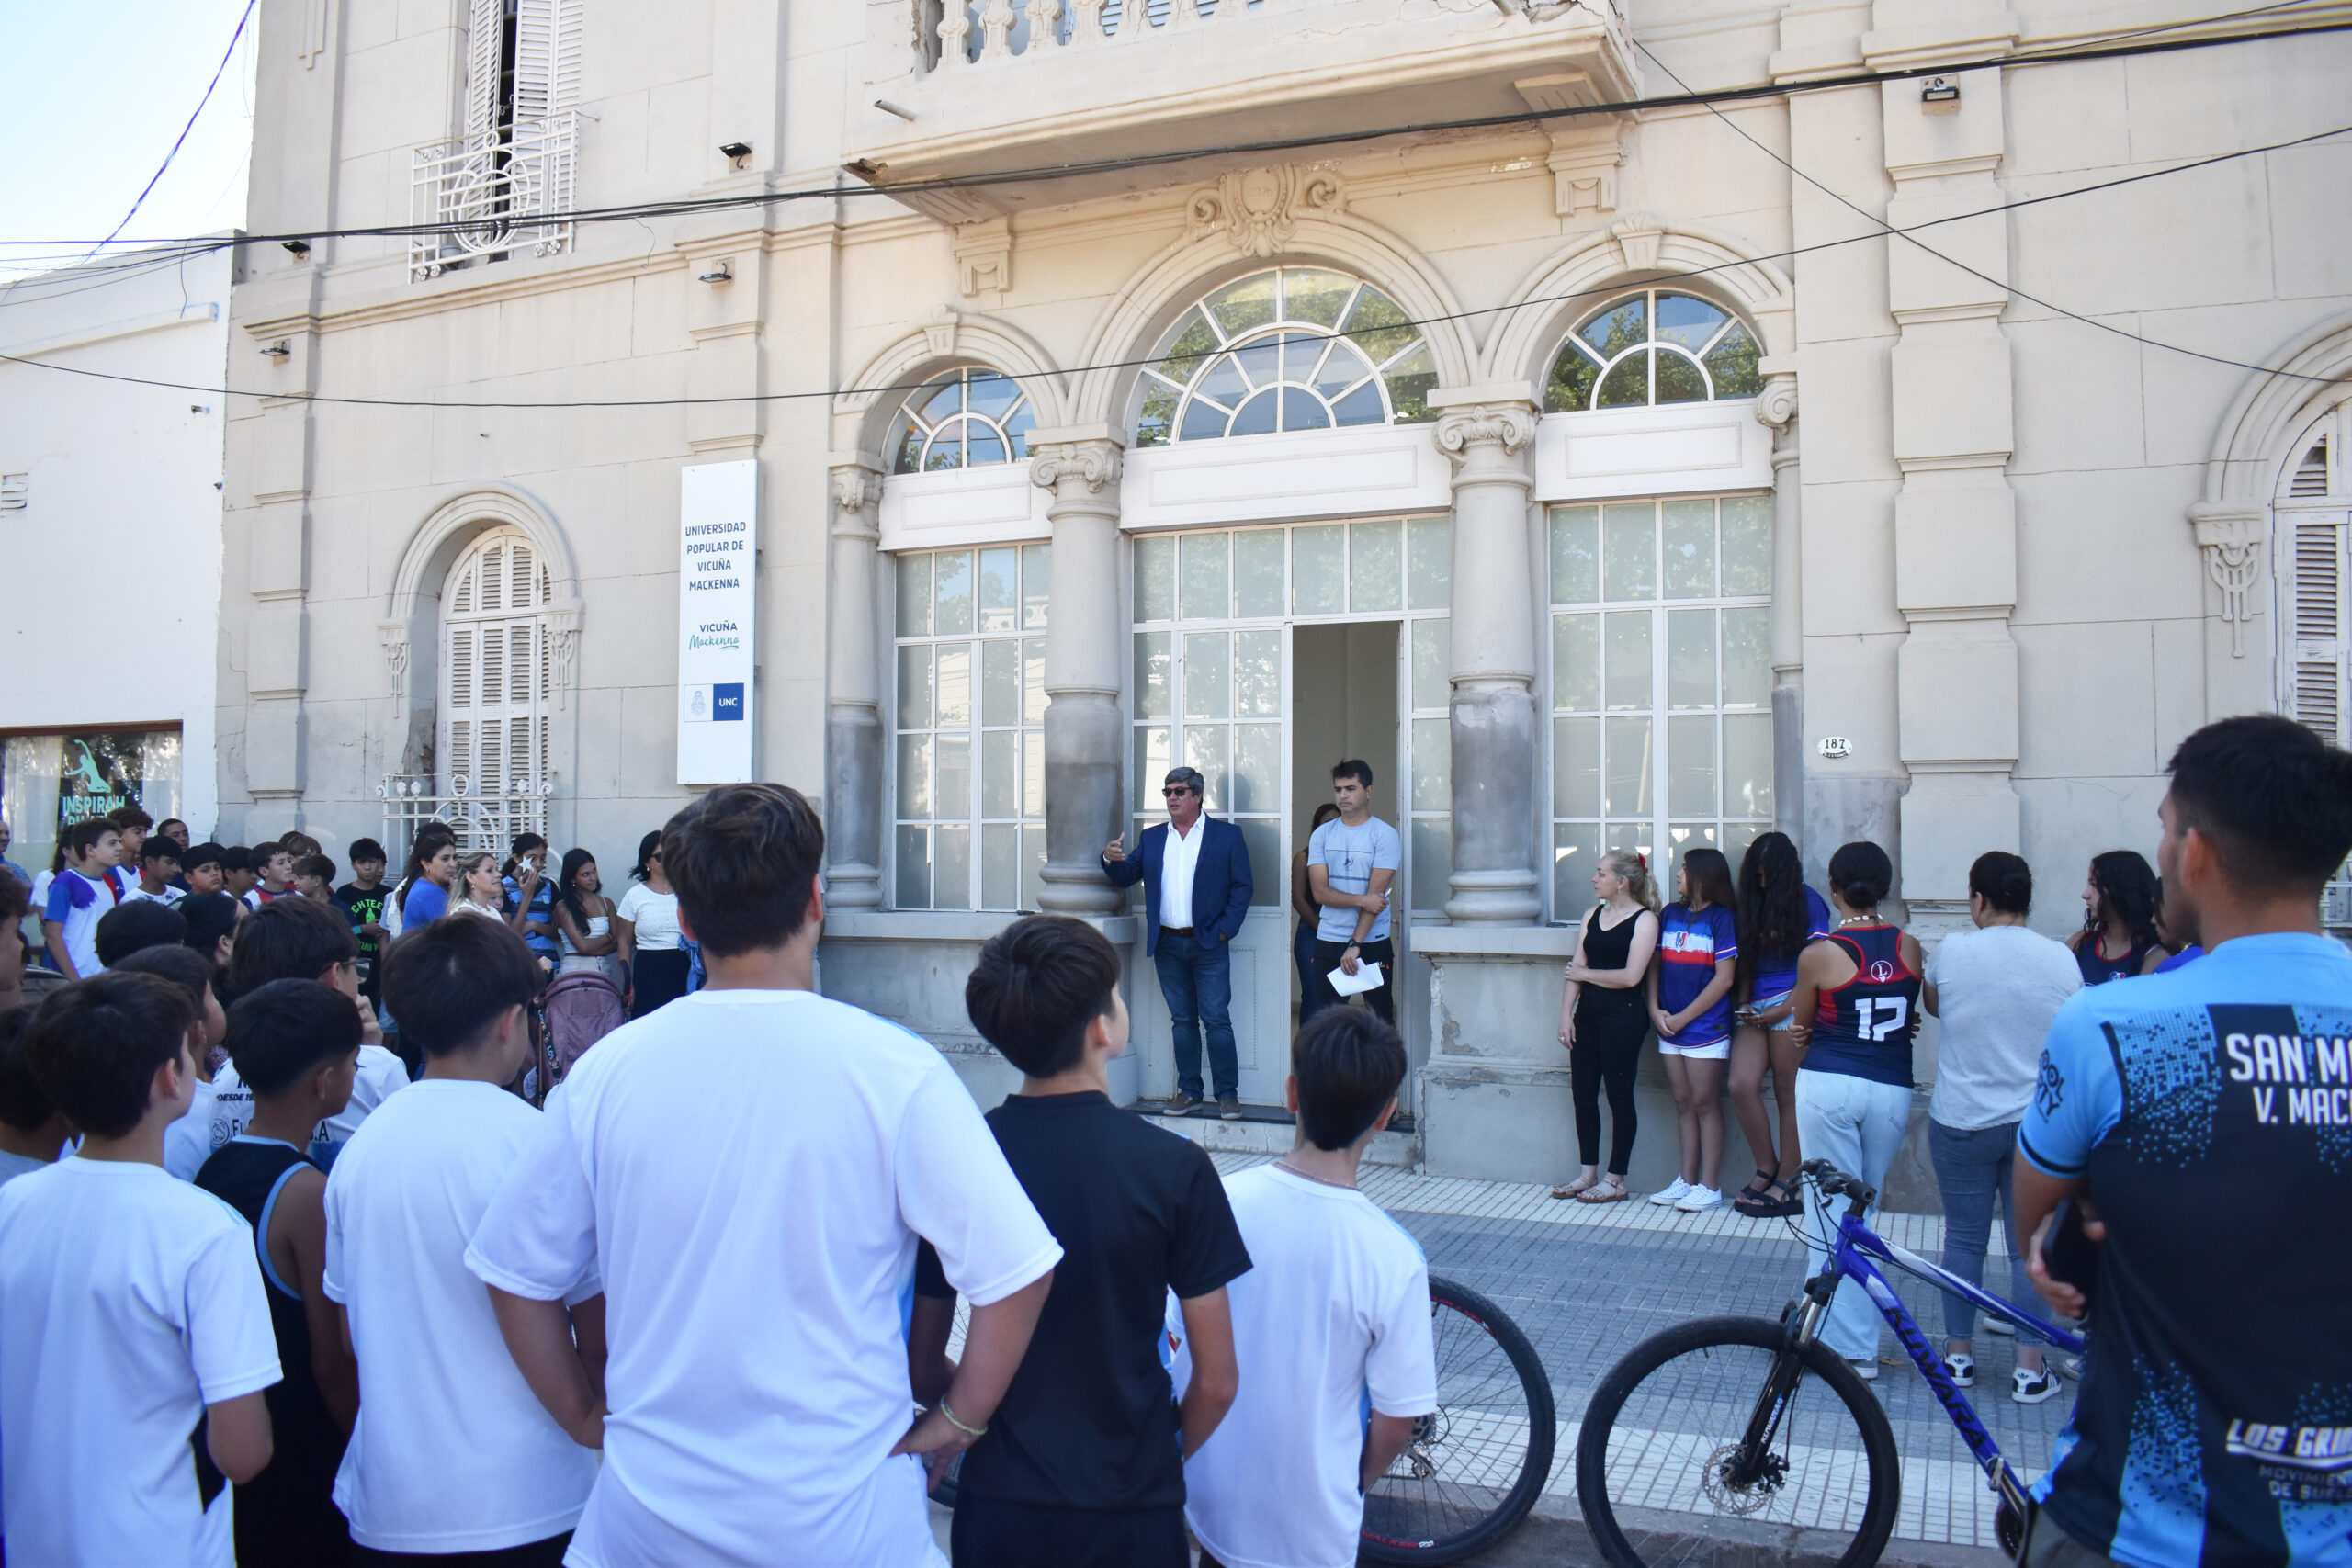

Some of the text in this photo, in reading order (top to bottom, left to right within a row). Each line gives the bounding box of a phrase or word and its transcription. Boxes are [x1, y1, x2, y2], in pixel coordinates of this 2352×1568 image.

[685, 521, 746, 536] UNIVERSIDAD
[686, 540, 744, 555] POPULAR DE
[697, 558, 731, 572] VICUÑA
[689, 578, 740, 592] MACKENNA
[699, 619, 738, 632] VICUÑA
[689, 634, 740, 650] Mackenna
[718, 697, 738, 707] UNC
[1825, 738, 1845, 750] 187
[2225, 1032, 2352, 1084] SAN M
[2252, 1086, 2352, 1125] V. MAC
[1885, 1307, 1987, 1450] KUWARA
[2226, 1417, 2289, 1453] LOS
